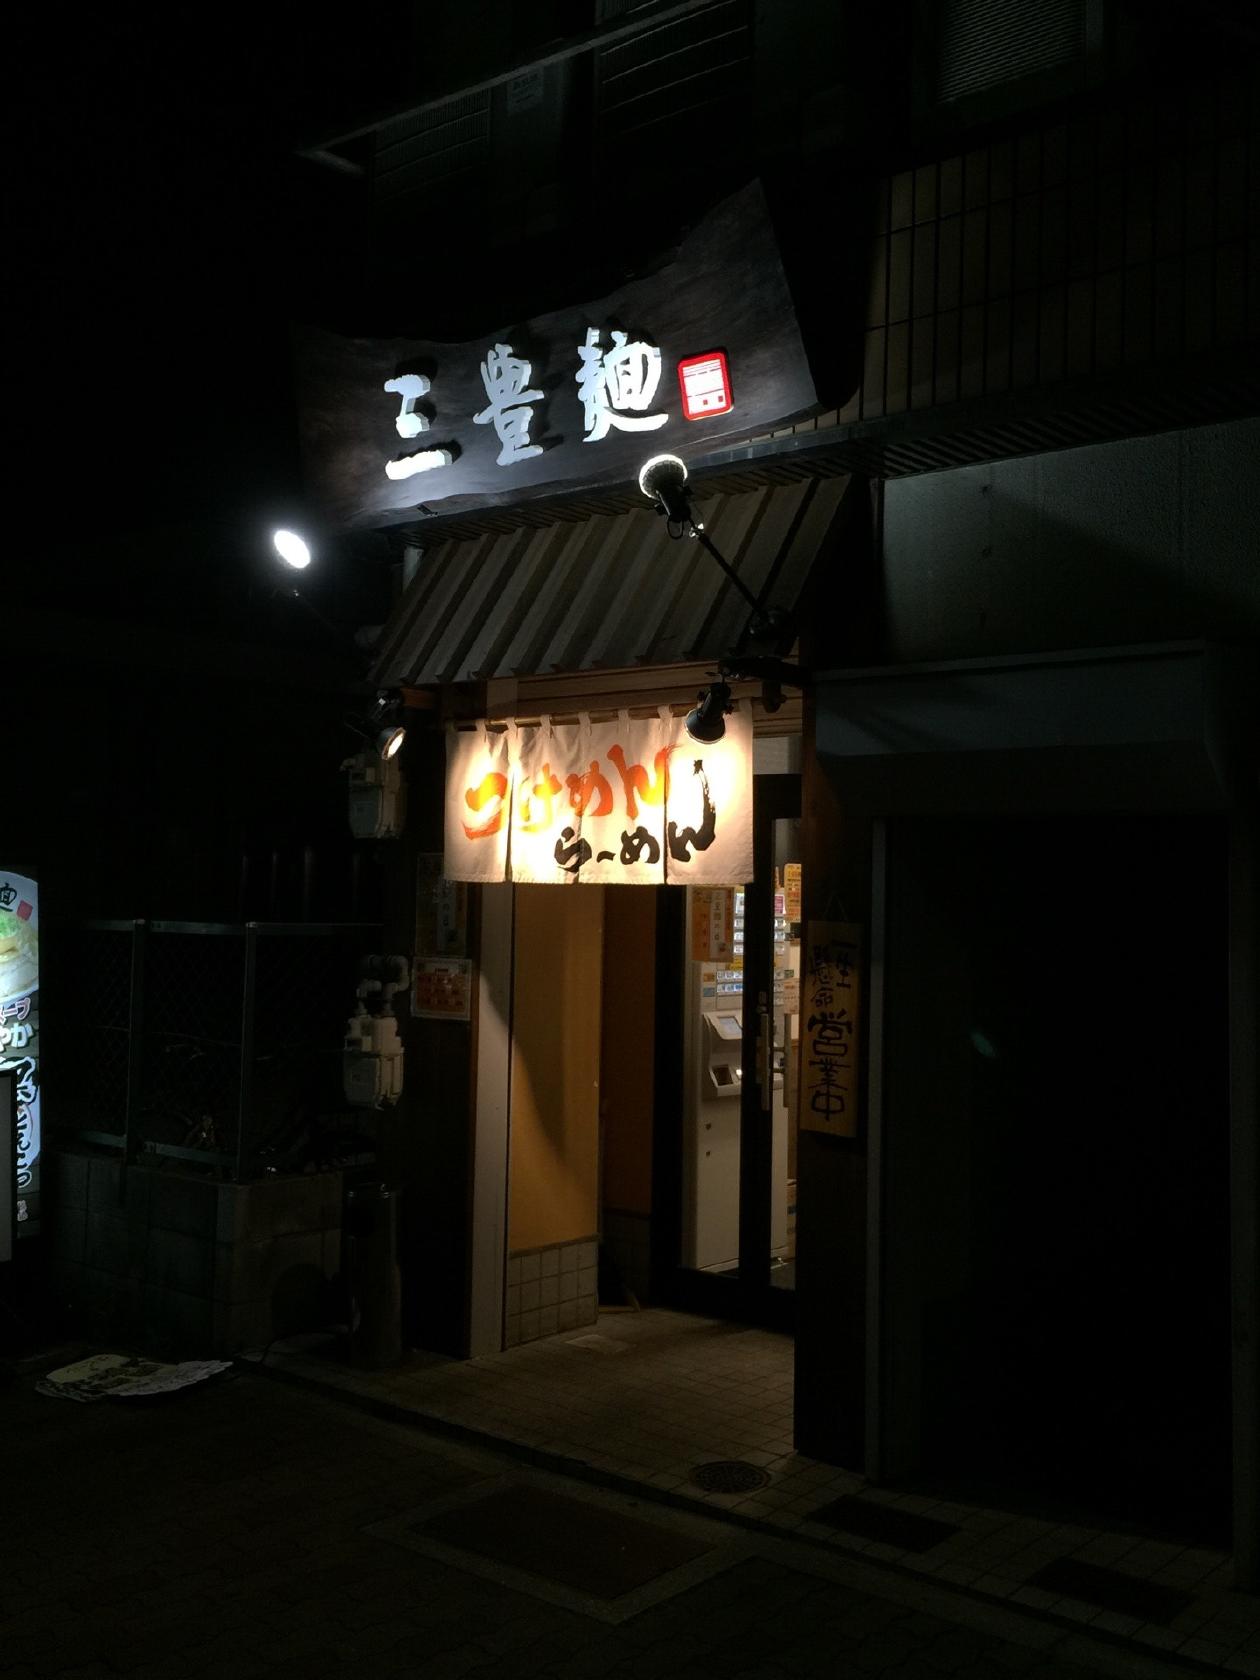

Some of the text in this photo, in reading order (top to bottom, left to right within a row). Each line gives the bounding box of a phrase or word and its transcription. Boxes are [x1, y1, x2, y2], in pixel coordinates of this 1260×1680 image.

[461, 744, 680, 840] つけめん
[807, 1009, 853, 1121] 営業中
